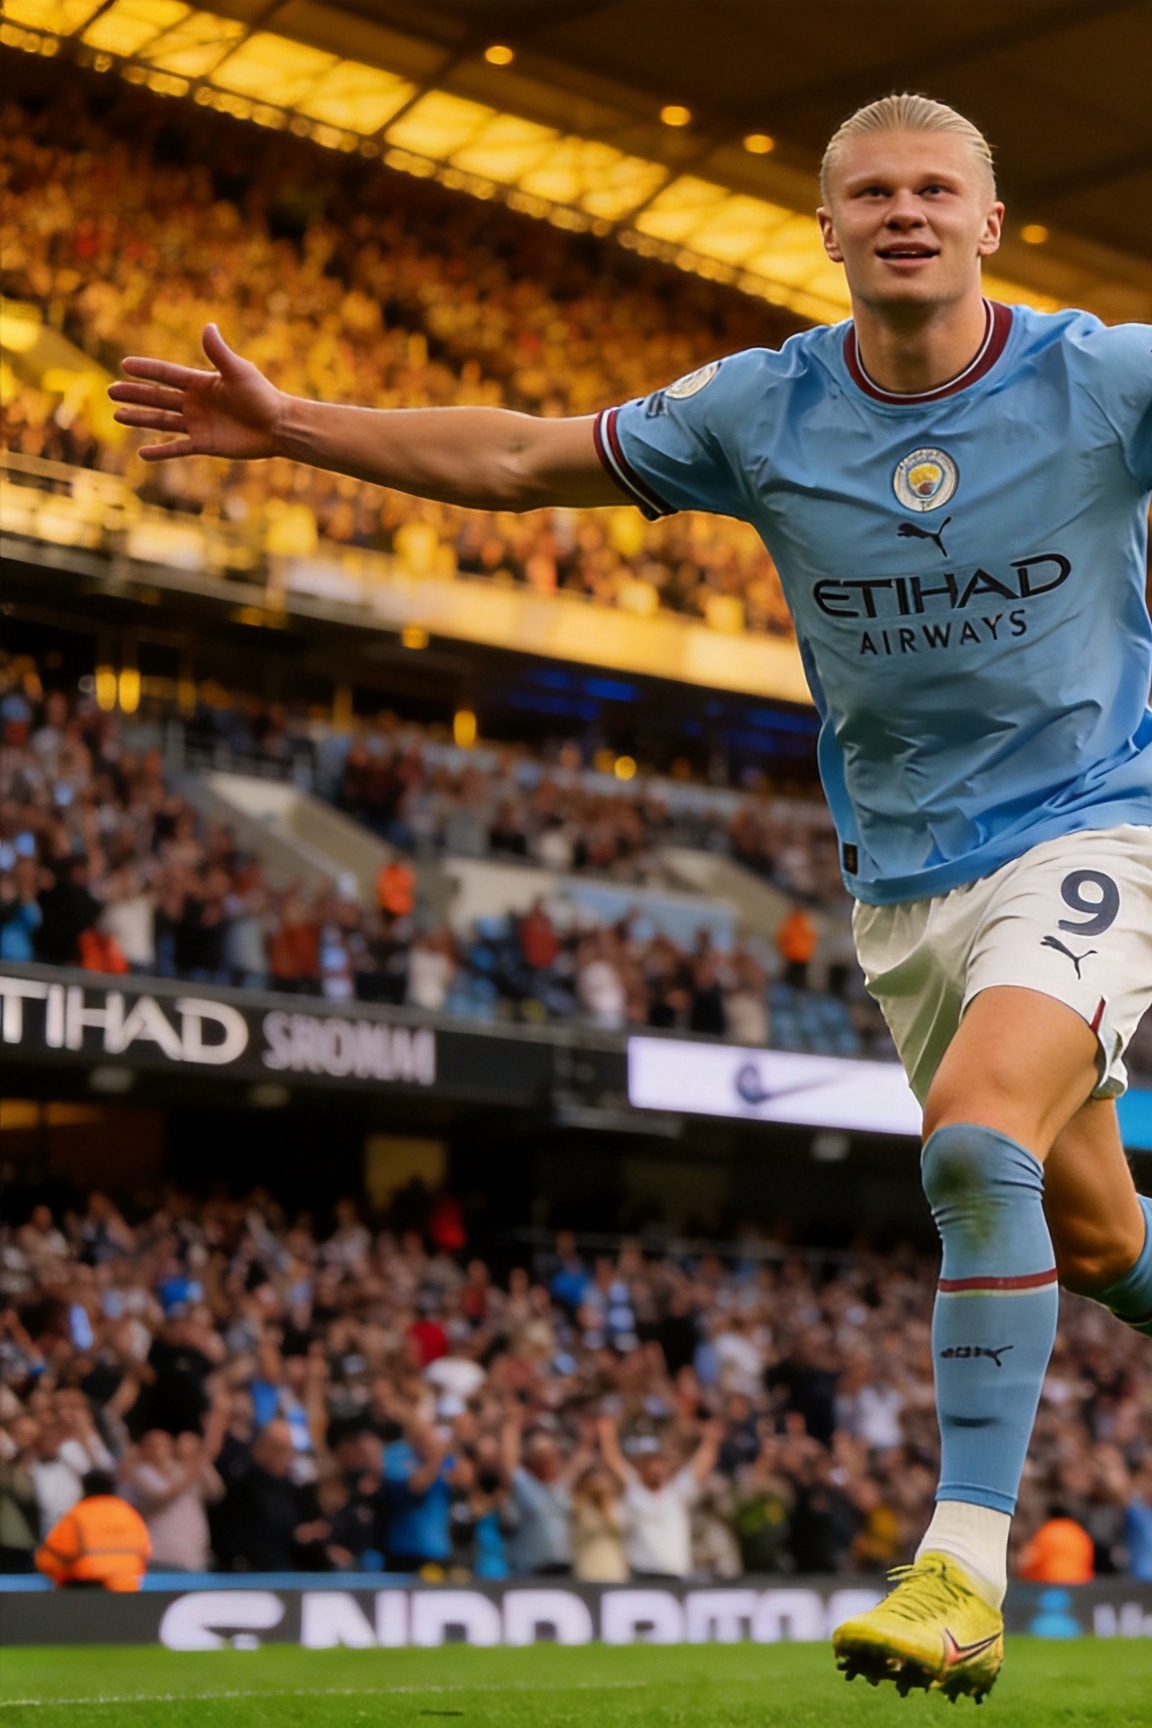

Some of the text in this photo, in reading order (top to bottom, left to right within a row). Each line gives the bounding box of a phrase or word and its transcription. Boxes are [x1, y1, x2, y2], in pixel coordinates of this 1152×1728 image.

[813, 553, 1072, 618] ETIHAD
[859, 609, 1028, 655] AIRWAYS
[1058, 869, 1120, 936] 9
